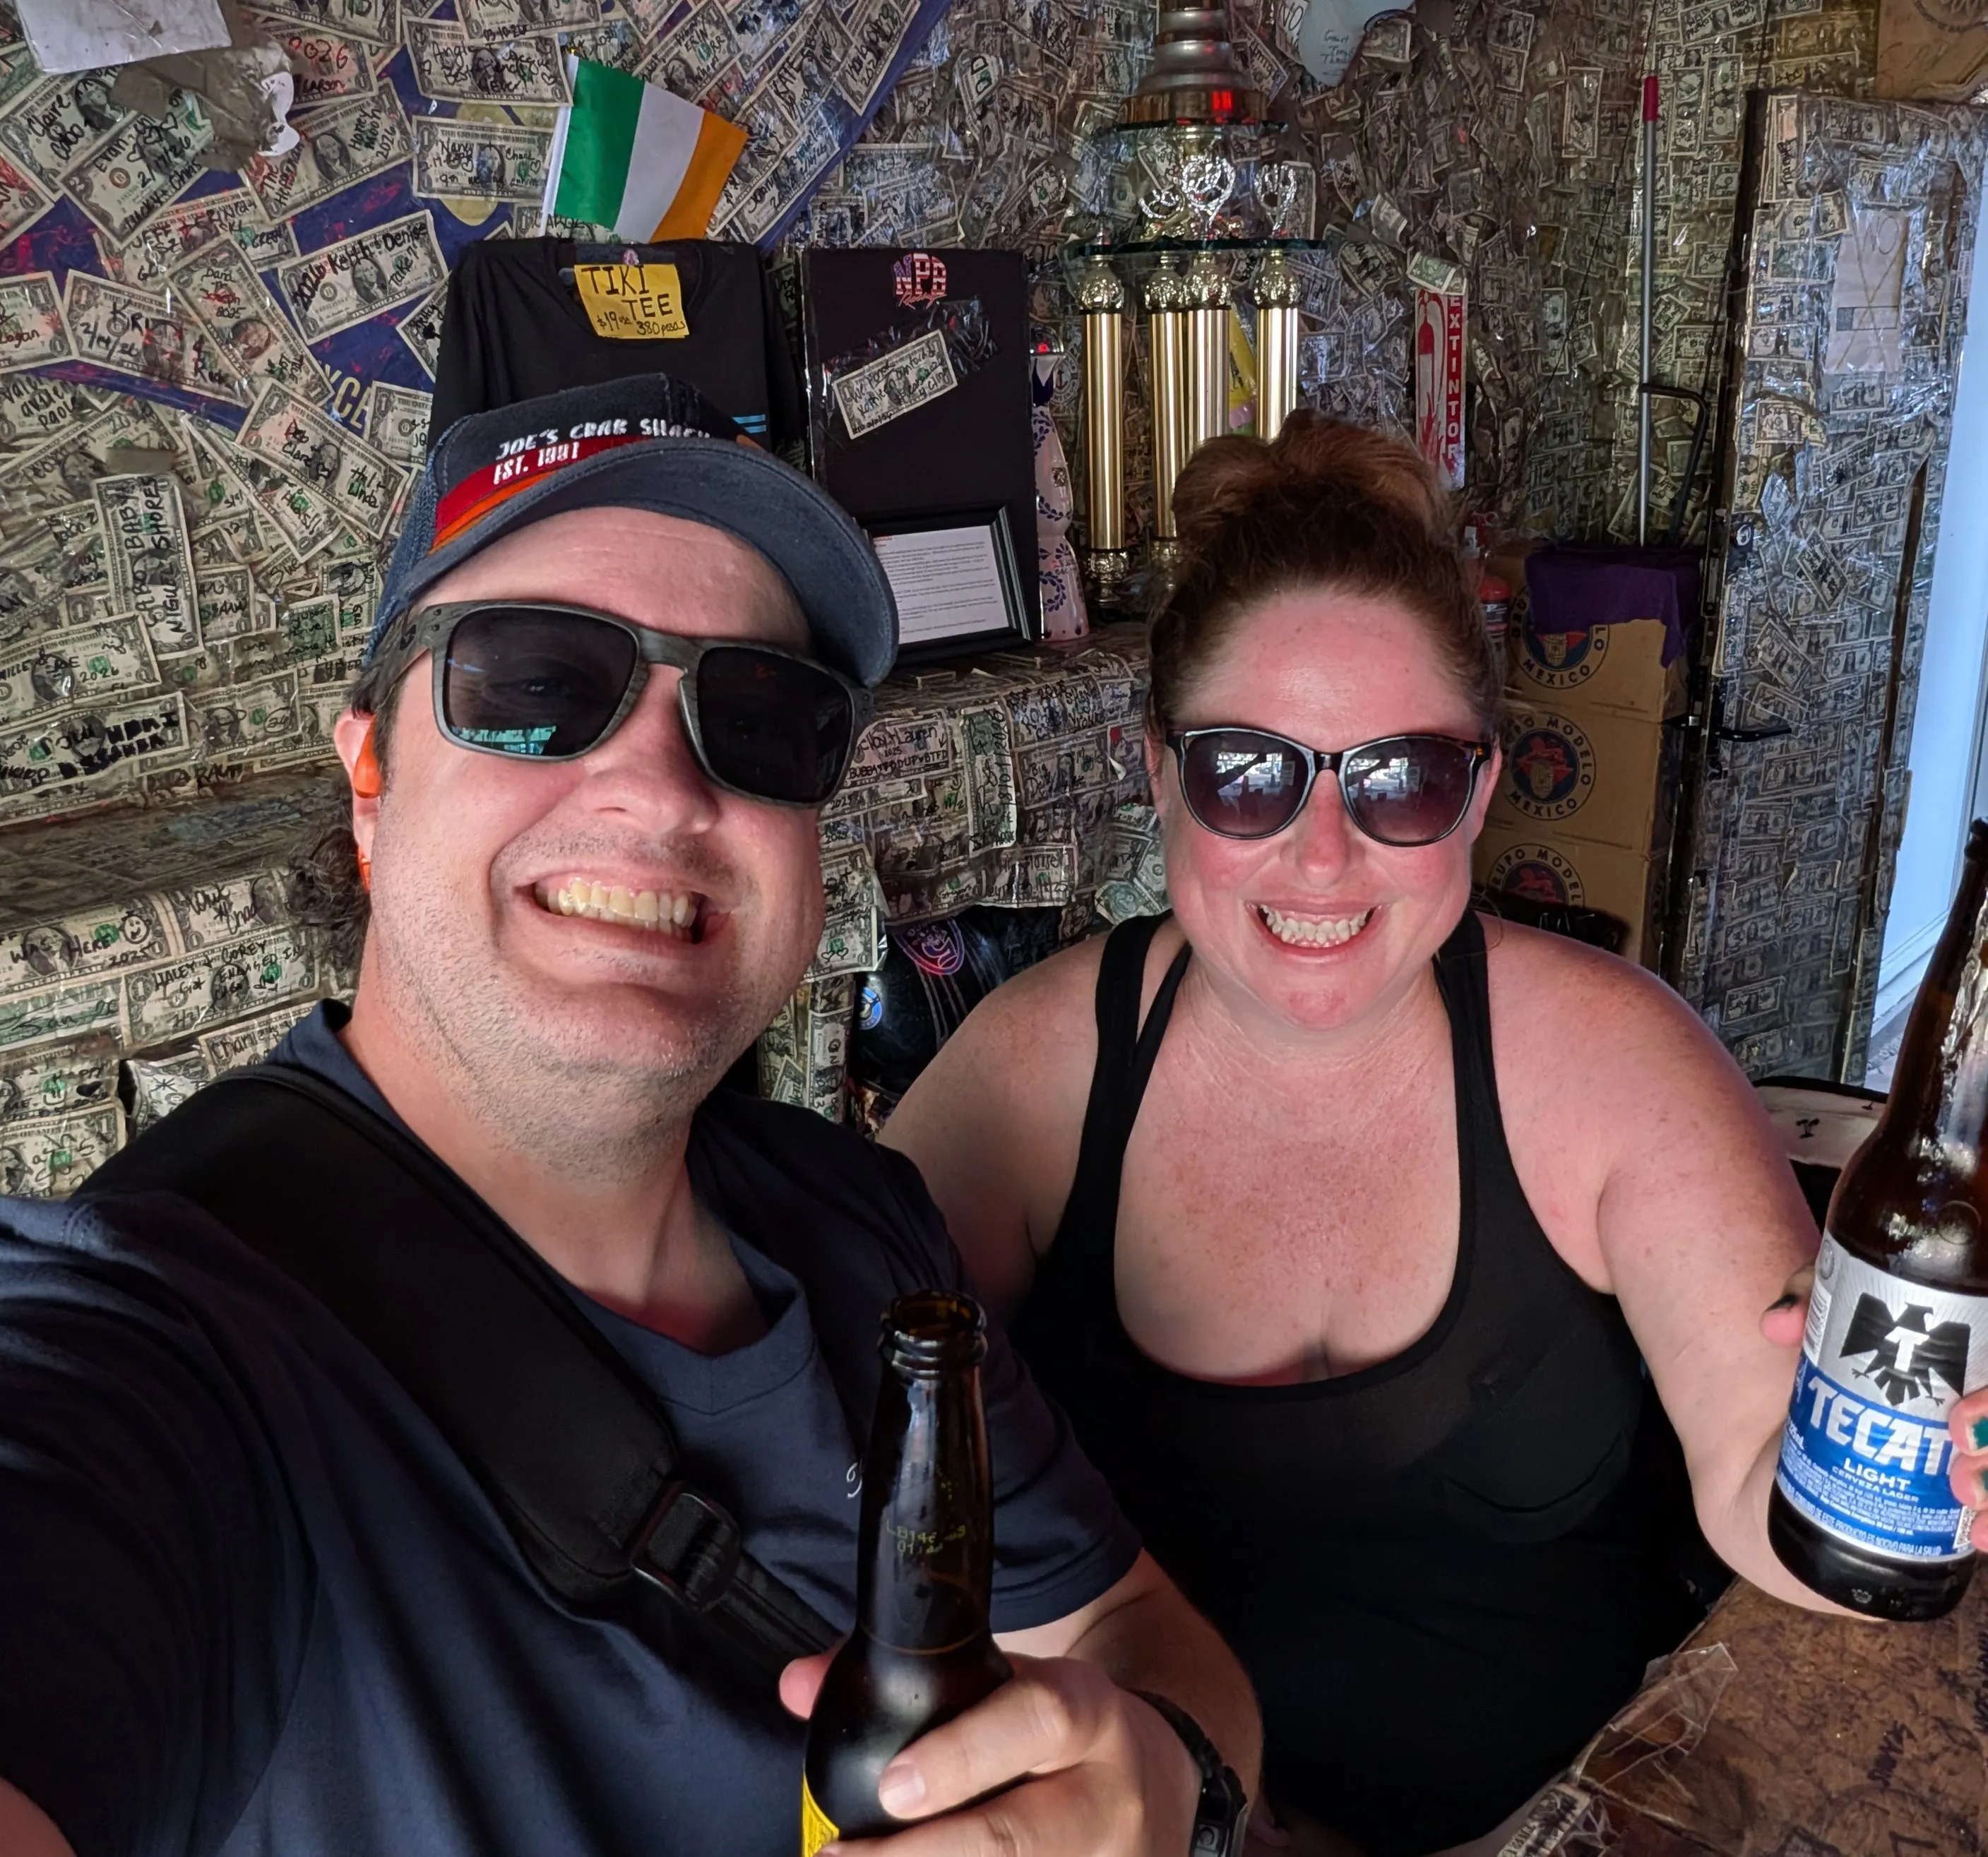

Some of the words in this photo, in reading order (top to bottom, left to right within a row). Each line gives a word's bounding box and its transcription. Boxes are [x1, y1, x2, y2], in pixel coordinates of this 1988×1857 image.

[382, 222, 427, 251] Denise
[581, 263, 649, 296] TIKI
[596, 311, 620, 332] $19
[636, 320, 660, 335] 380
[621, 293, 673, 321] TEE
[1446, 295, 1463, 460] EXTINTOR
[495, 428, 559, 461] JOE'S
[569, 418, 629, 440] CRAB
[492, 454, 529, 485] EST.
[78, 667, 120, 683] 2026
[1523, 658, 1591, 686] MEXICO
[1546, 715, 1592, 787] MODELO
[1508, 790, 1578, 818] MEXICO
[1536, 849, 1582, 902] MODEL
[1883, 1325, 1930, 1372] T
[1807, 1375, 1954, 1477] TECAT
[1831, 1466, 1880, 1493] CERVEZA
[1881, 1488, 1919, 1503] LAGER
[1843, 1457, 1912, 1492] LIGHT
[1821, 1510, 1836, 1526] ESTE
[1835, 1517, 1867, 1541] PRODUCTO
[1899, 1542, 1915, 1554] PARA
[1923, 1544, 1942, 1556] SALUD
